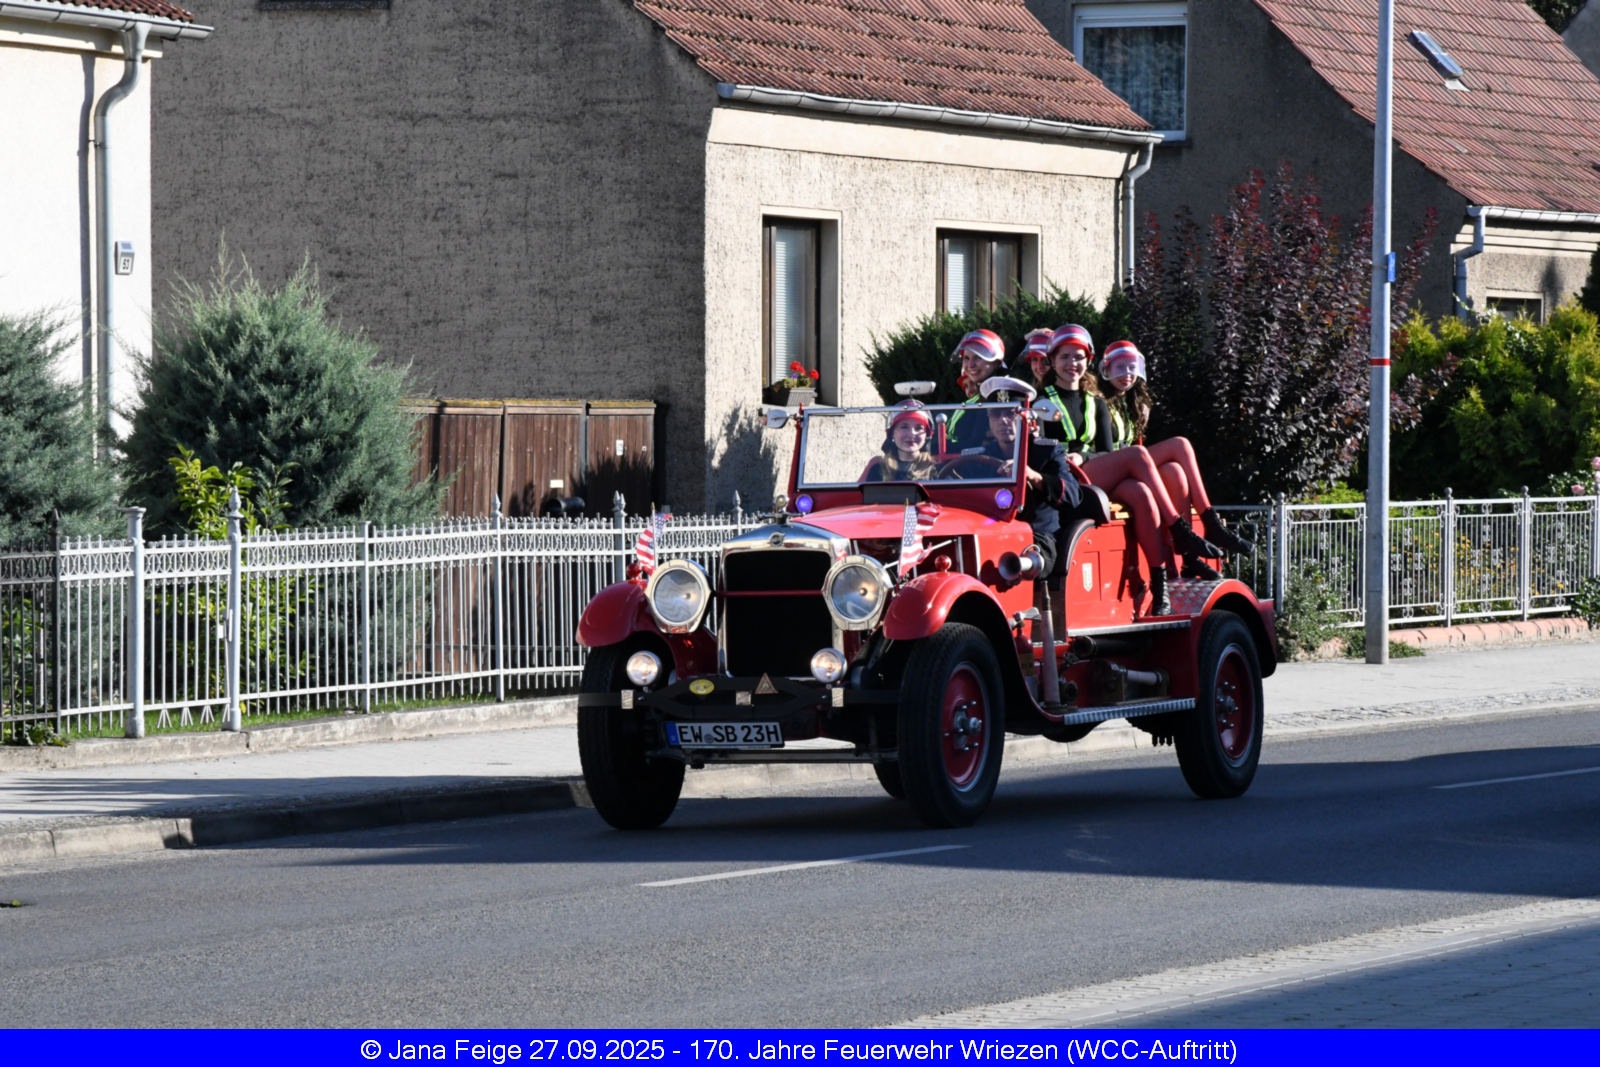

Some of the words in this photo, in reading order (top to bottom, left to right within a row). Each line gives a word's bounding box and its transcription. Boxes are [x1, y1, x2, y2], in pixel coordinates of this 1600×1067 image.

[677, 725, 703, 743] EW
[712, 725, 737, 743] SB
[741, 725, 779, 743] 23H
